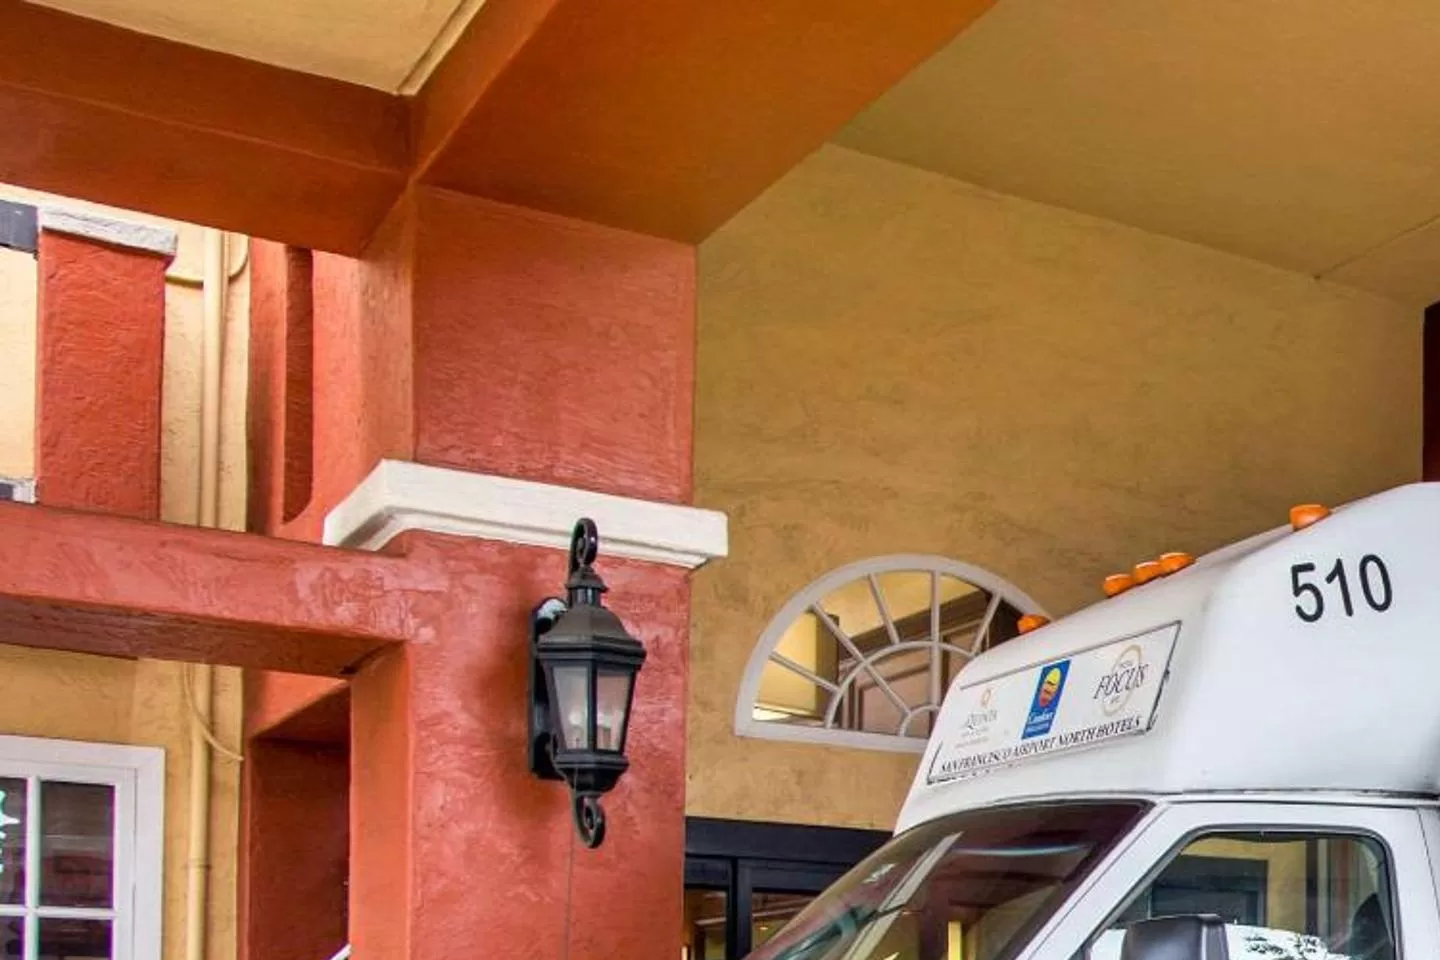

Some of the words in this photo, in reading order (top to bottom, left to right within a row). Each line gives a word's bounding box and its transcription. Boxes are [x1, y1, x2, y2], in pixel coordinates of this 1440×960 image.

[1291, 554, 1393, 623] 510
[1093, 663, 1150, 700] FOCUS
[1014, 736, 1057, 757] AIRPORT
[1058, 726, 1096, 746] NORTH
[1096, 715, 1142, 739] HOTELS
